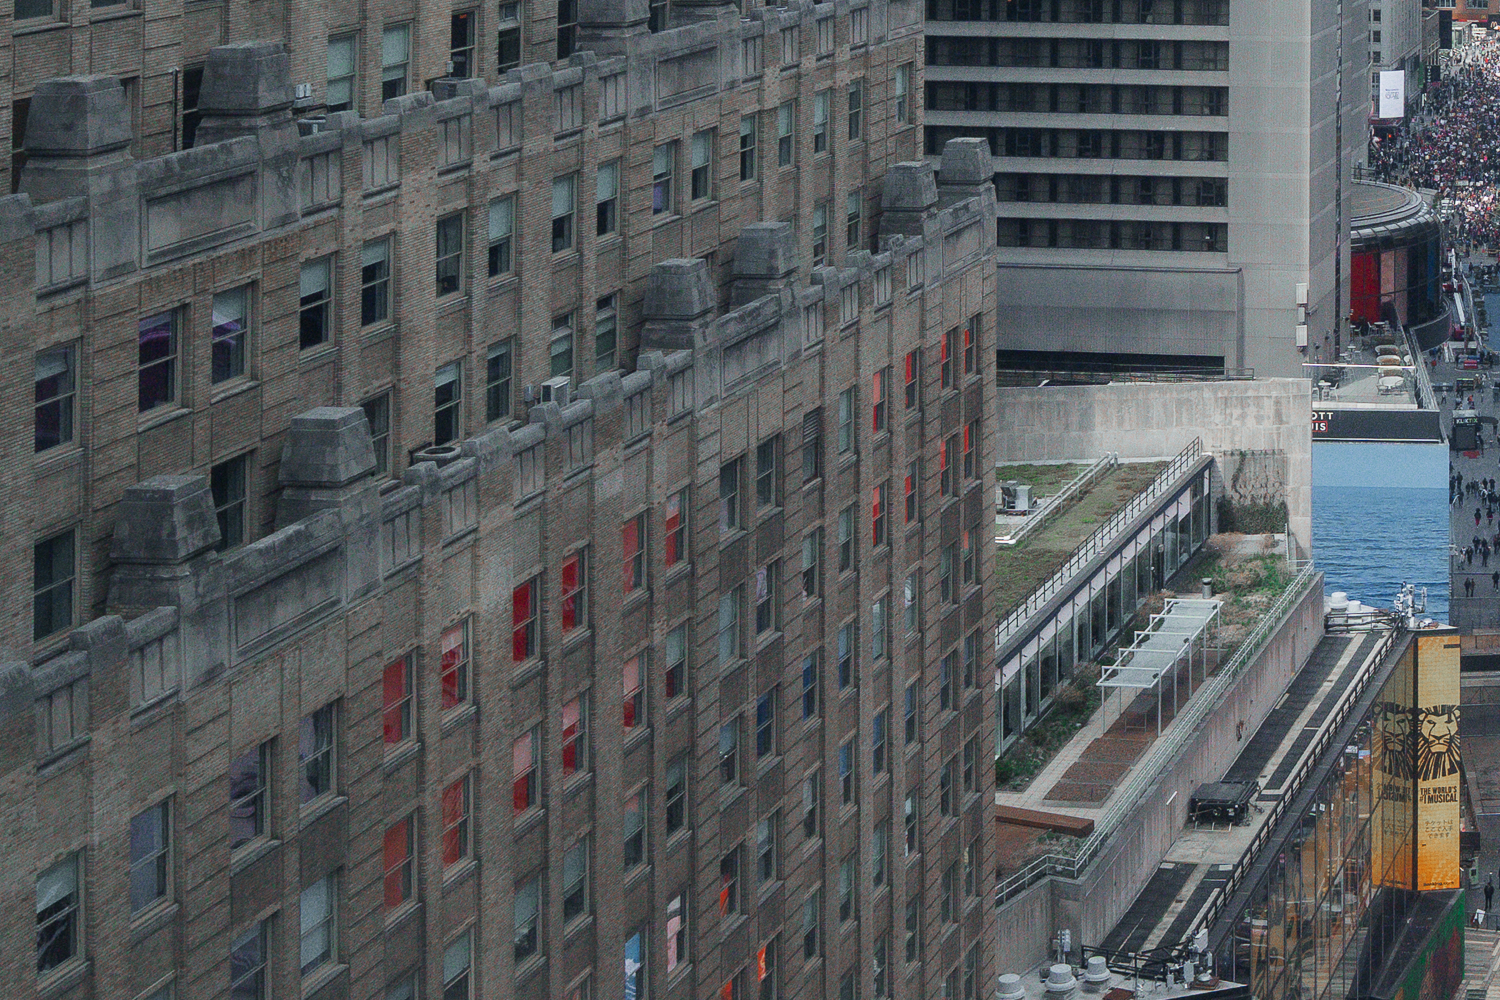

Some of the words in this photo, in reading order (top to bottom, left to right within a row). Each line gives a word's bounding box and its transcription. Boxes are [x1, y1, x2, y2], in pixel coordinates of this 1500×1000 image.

[1420, 787, 1431, 796] THE
[1432, 785, 1457, 795] WORLD'S
[1427, 792, 1459, 804] MUSICAL
